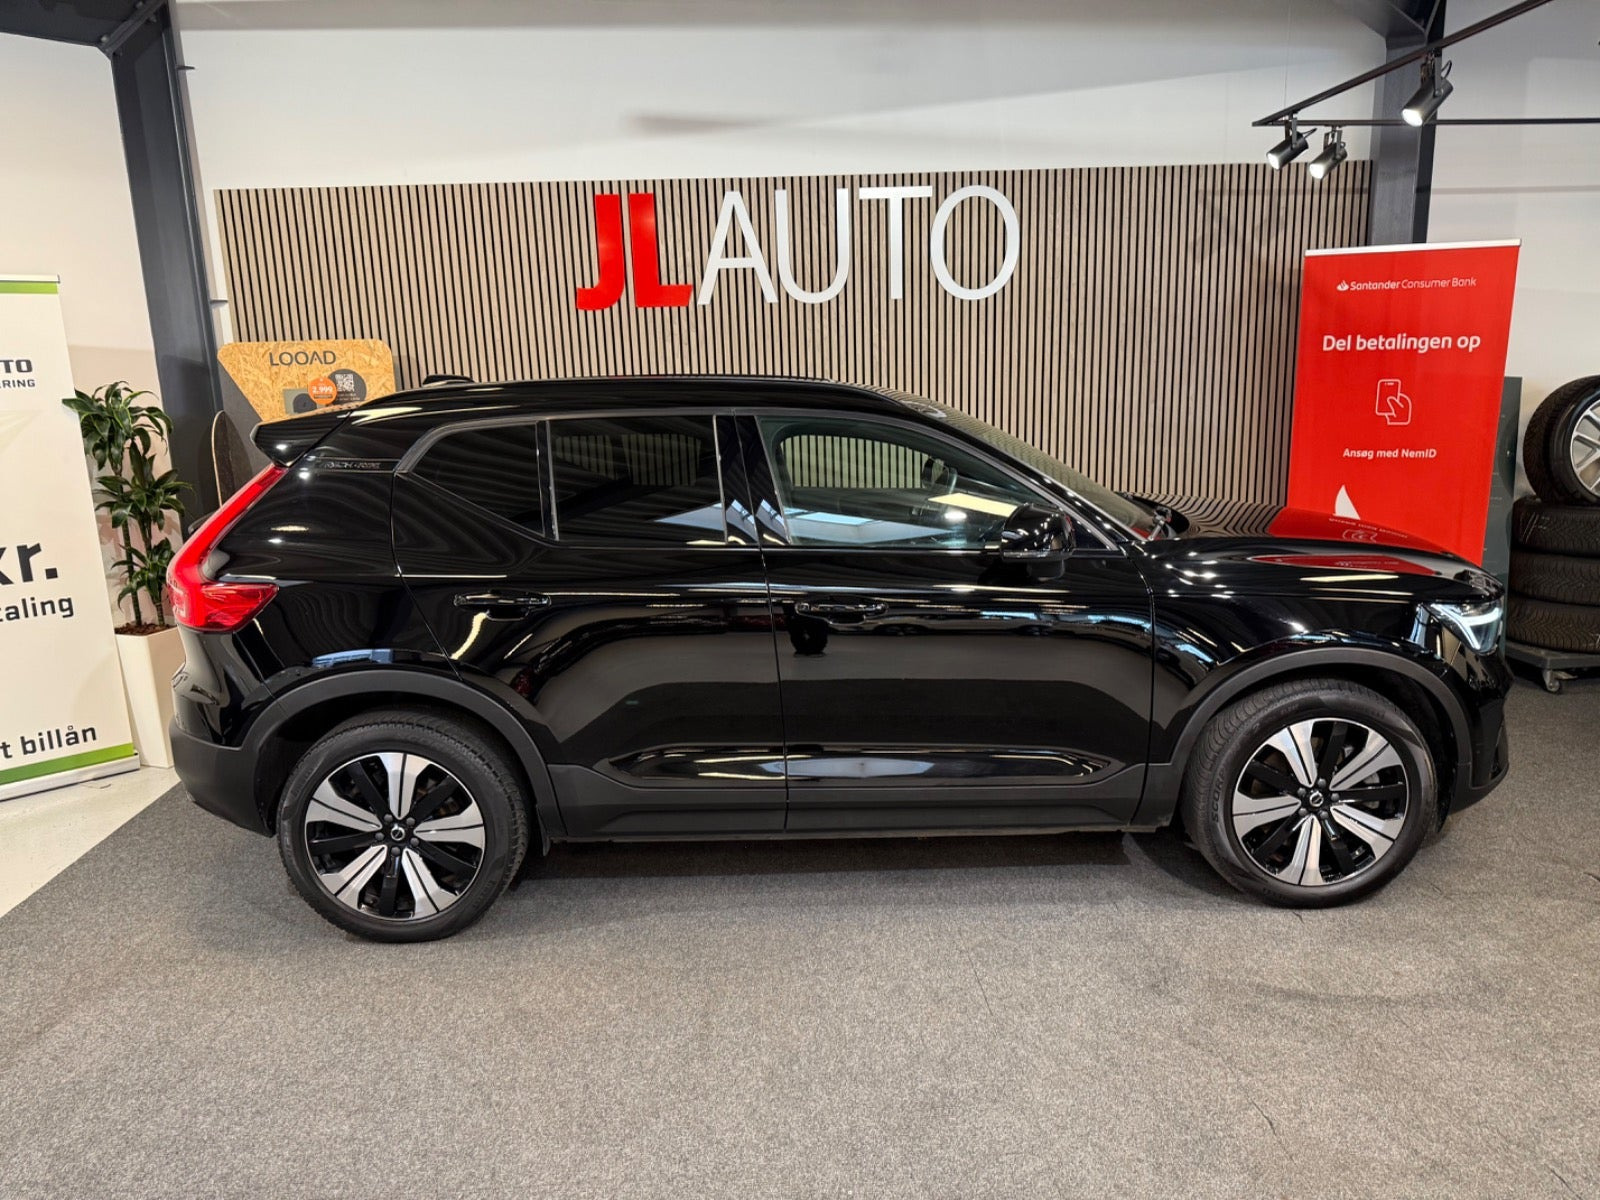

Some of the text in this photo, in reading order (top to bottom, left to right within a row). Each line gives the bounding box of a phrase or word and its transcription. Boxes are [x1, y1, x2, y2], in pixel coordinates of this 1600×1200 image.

[1350, 277, 1477, 291] Santander Consumer Bank
[1322, 333, 1481, 353] Del betalingen op
[269, 350, 336, 366] LOOAD
[0, 379, 35, 389] RING
[1343, 448, 1437, 460] Ansøg med NemID
[0, 596, 74, 622] aling
[20, 725, 97, 755] billån
